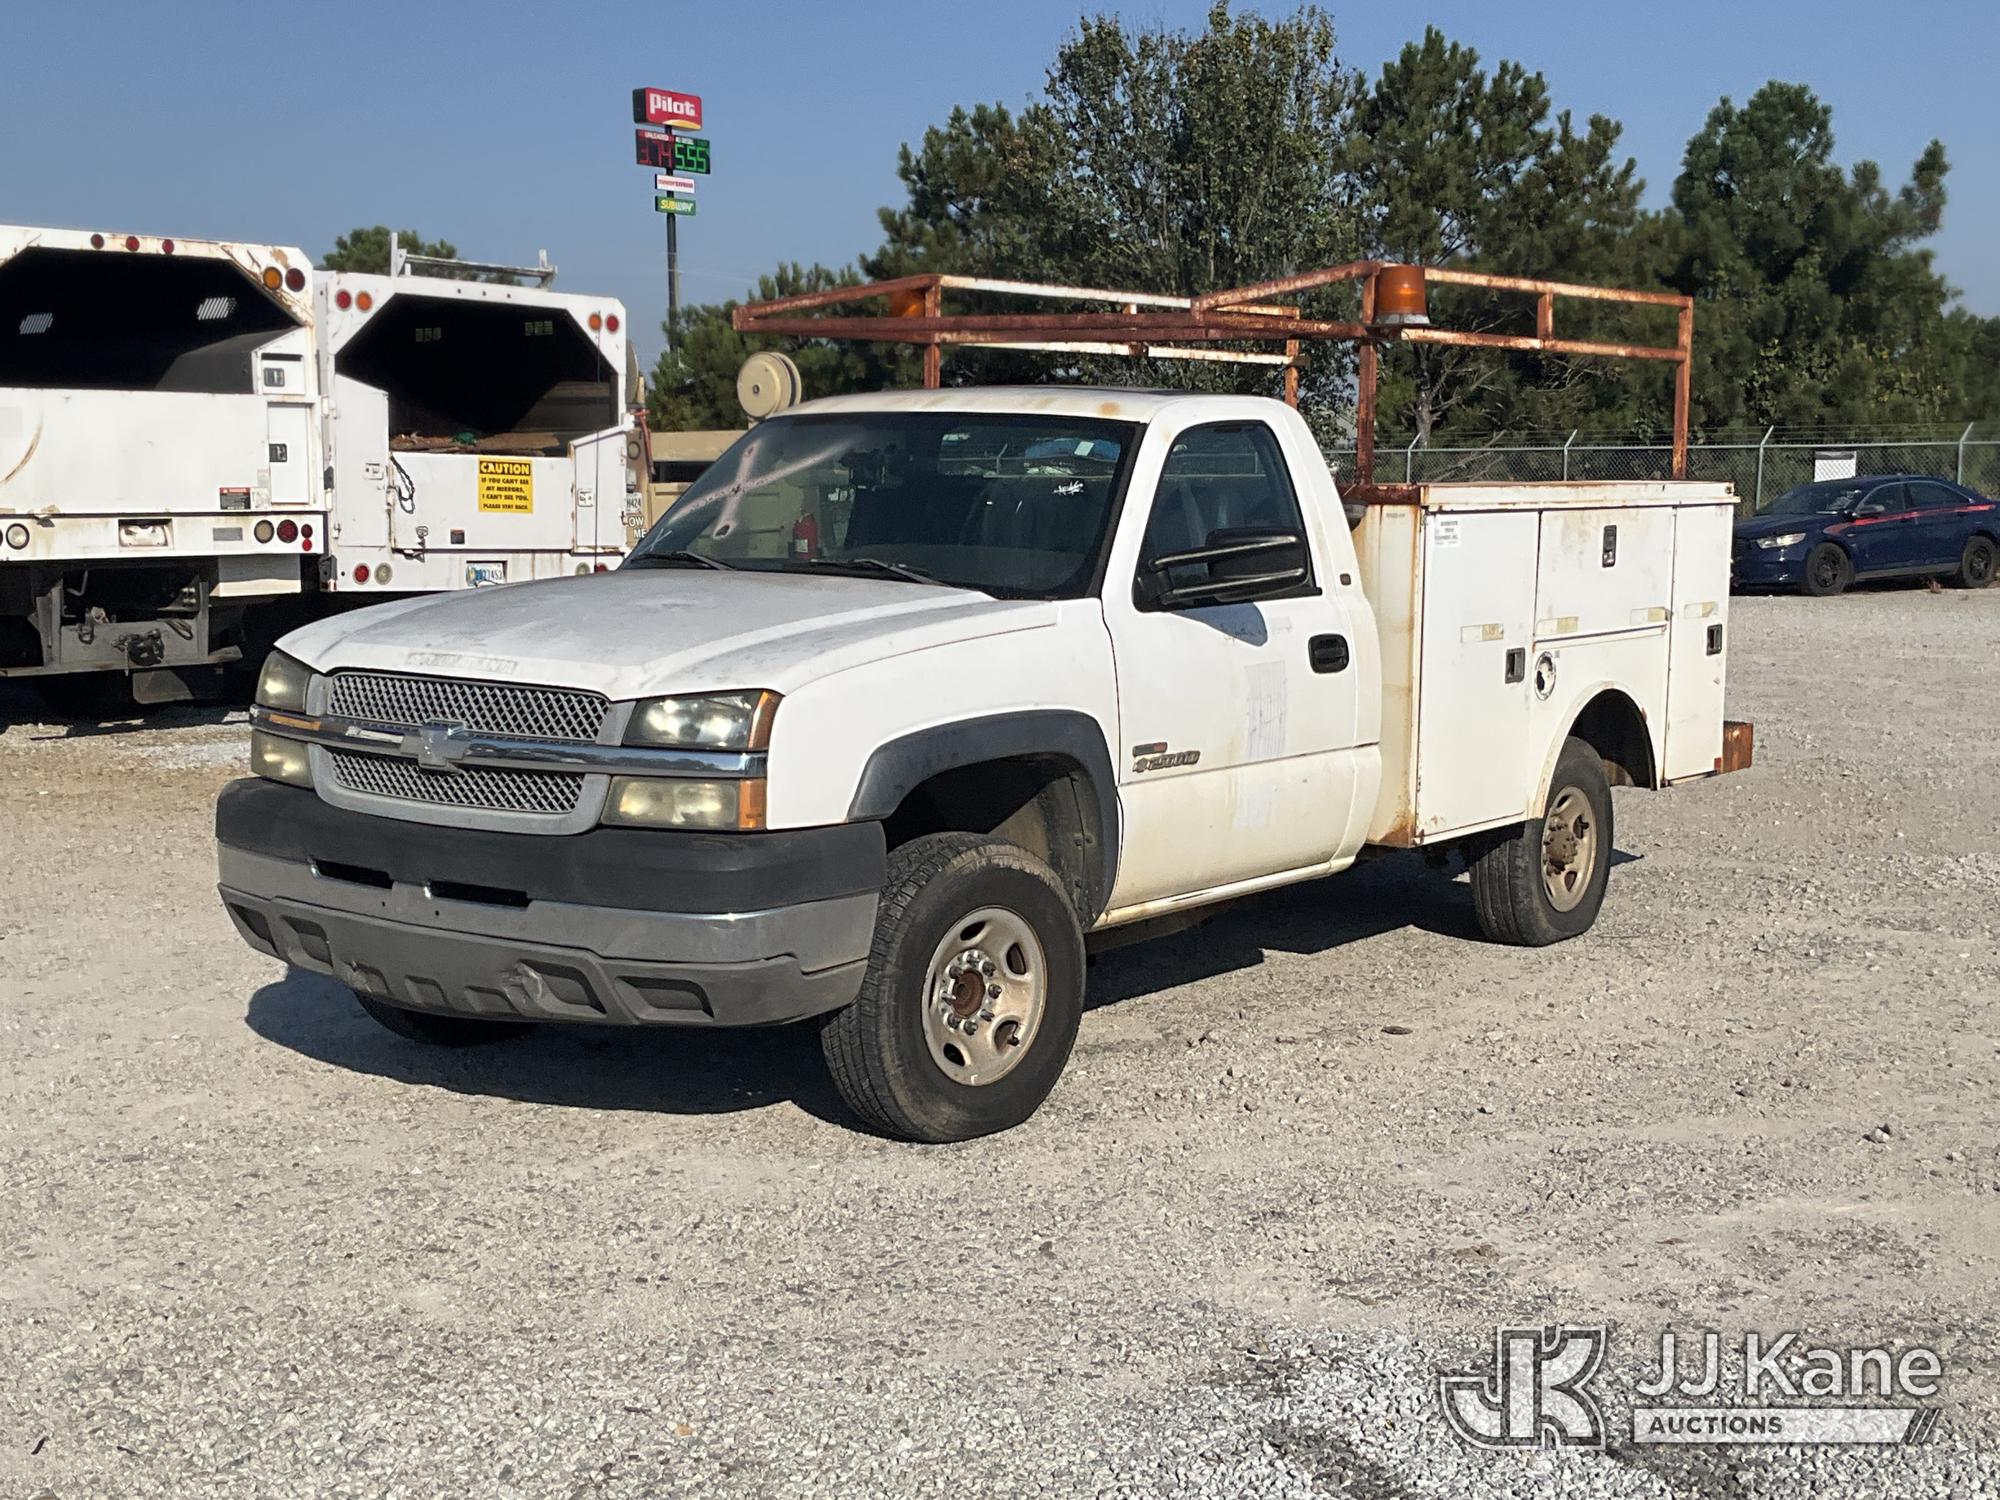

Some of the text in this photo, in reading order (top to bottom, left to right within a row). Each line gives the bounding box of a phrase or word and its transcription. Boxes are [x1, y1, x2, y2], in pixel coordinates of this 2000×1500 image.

[649, 93, 696, 117] Pilot
[661, 199, 693, 212] SUBWAY
[480, 462, 530, 475] CAUTION
[633, 529, 647, 539] ME
